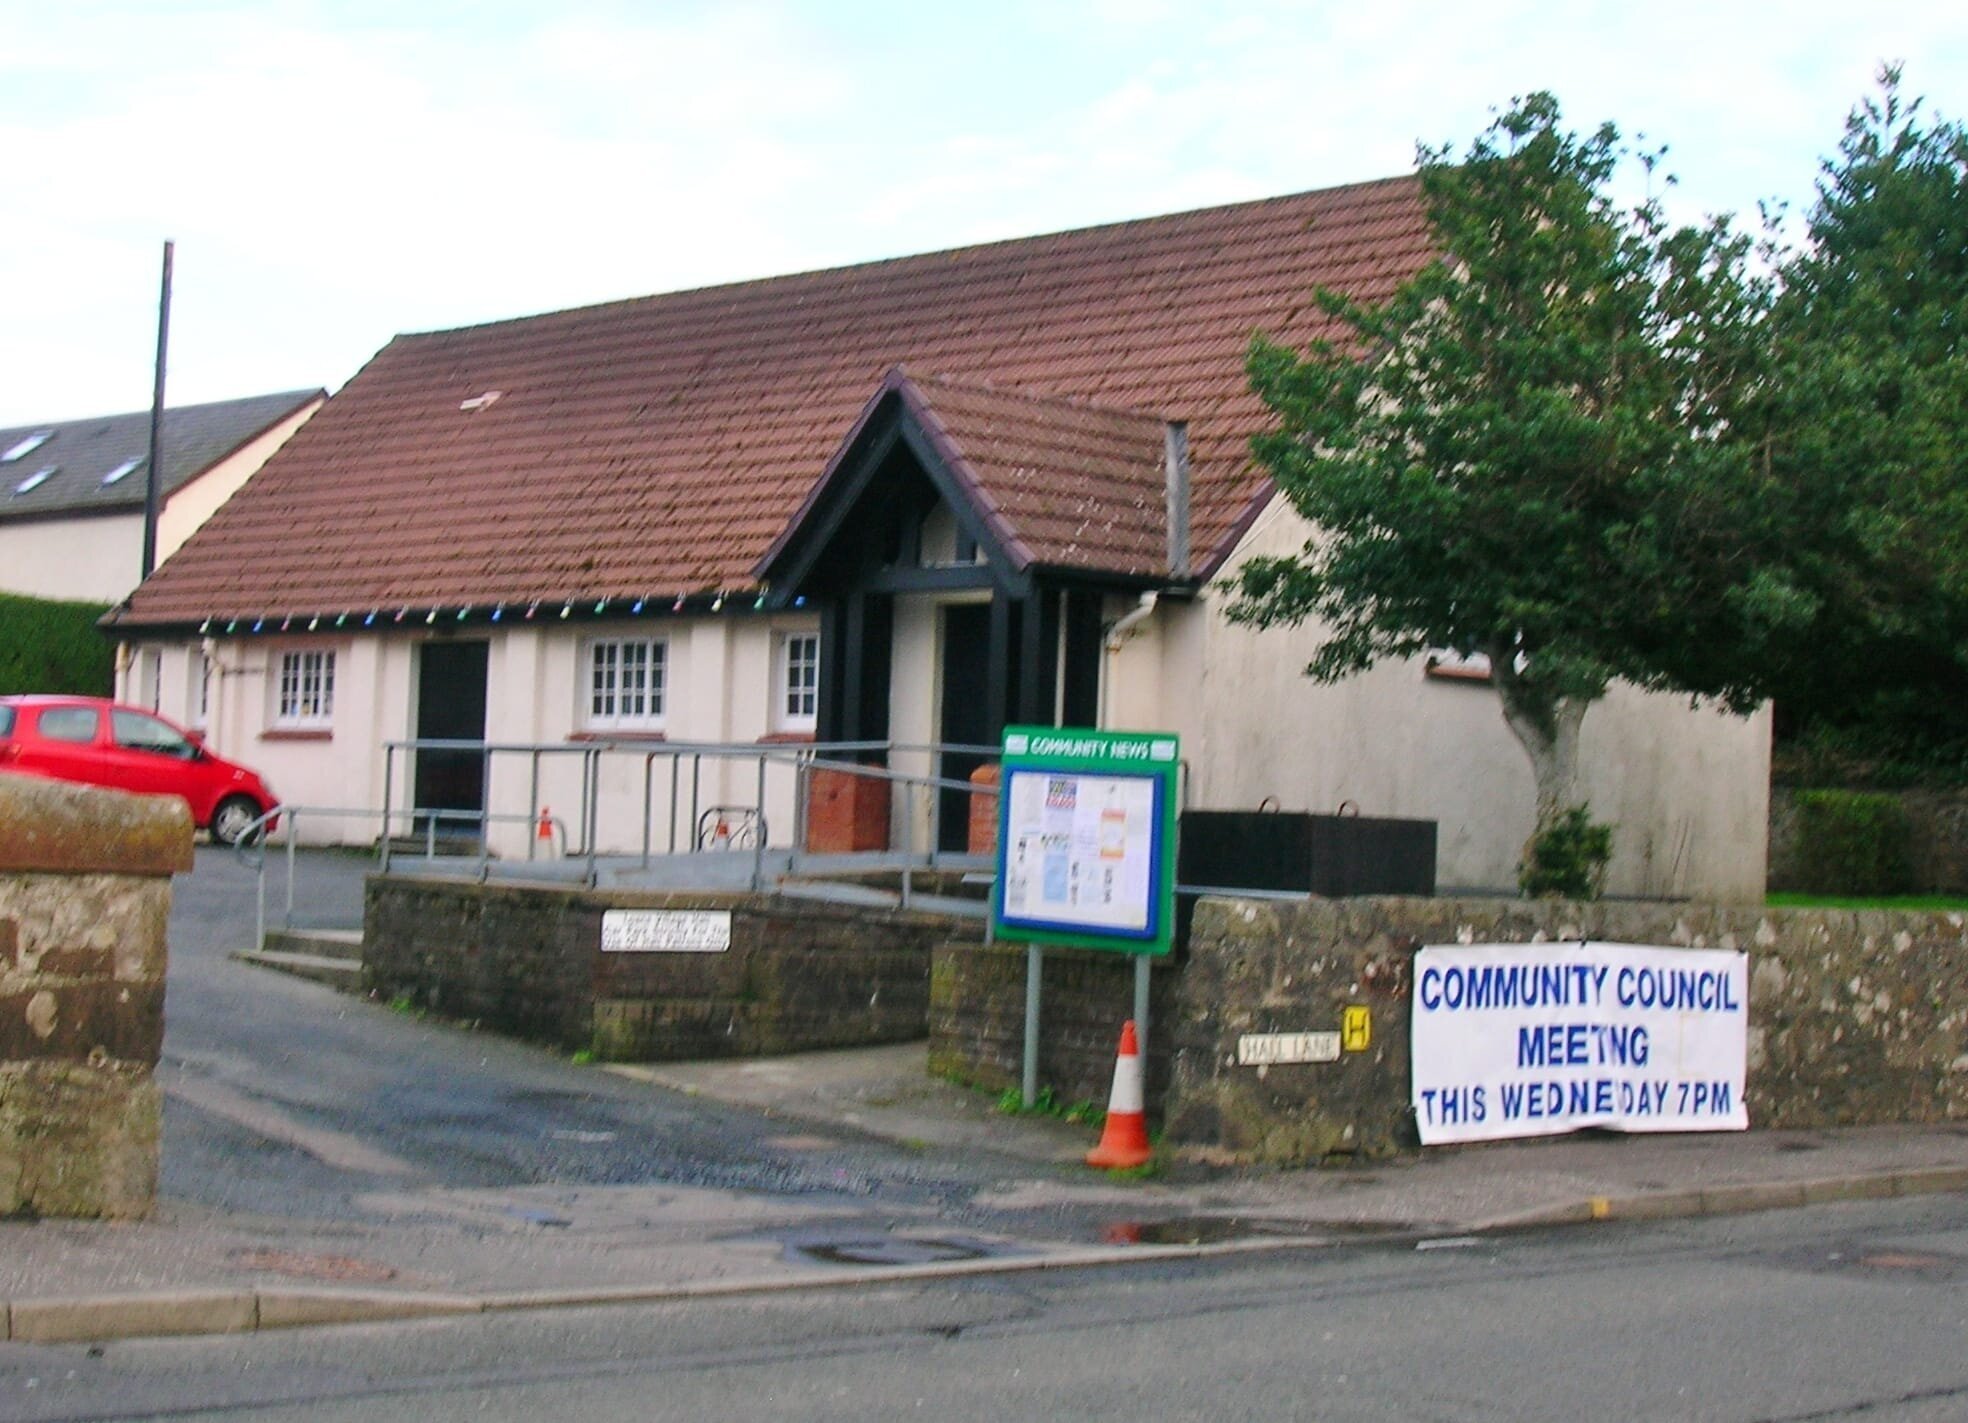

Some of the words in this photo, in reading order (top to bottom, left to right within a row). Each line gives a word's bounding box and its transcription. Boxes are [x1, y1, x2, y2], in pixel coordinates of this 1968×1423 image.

[1031, 736, 1108, 757] COMMUNITY
[1111, 742, 1148, 759] NEWS
[1421, 966, 1607, 1010] COMMUNITY
[1618, 968, 1738, 1010] COUNCIL
[1350, 1011, 1367, 1043] H
[1518, 1026, 1649, 1067] MEETNG
[1422, 1087, 1486, 1125] THIS
[1501, 1080, 1668, 1119] WEDNEDAY
[1677, 1082, 1731, 1115] 7PM
